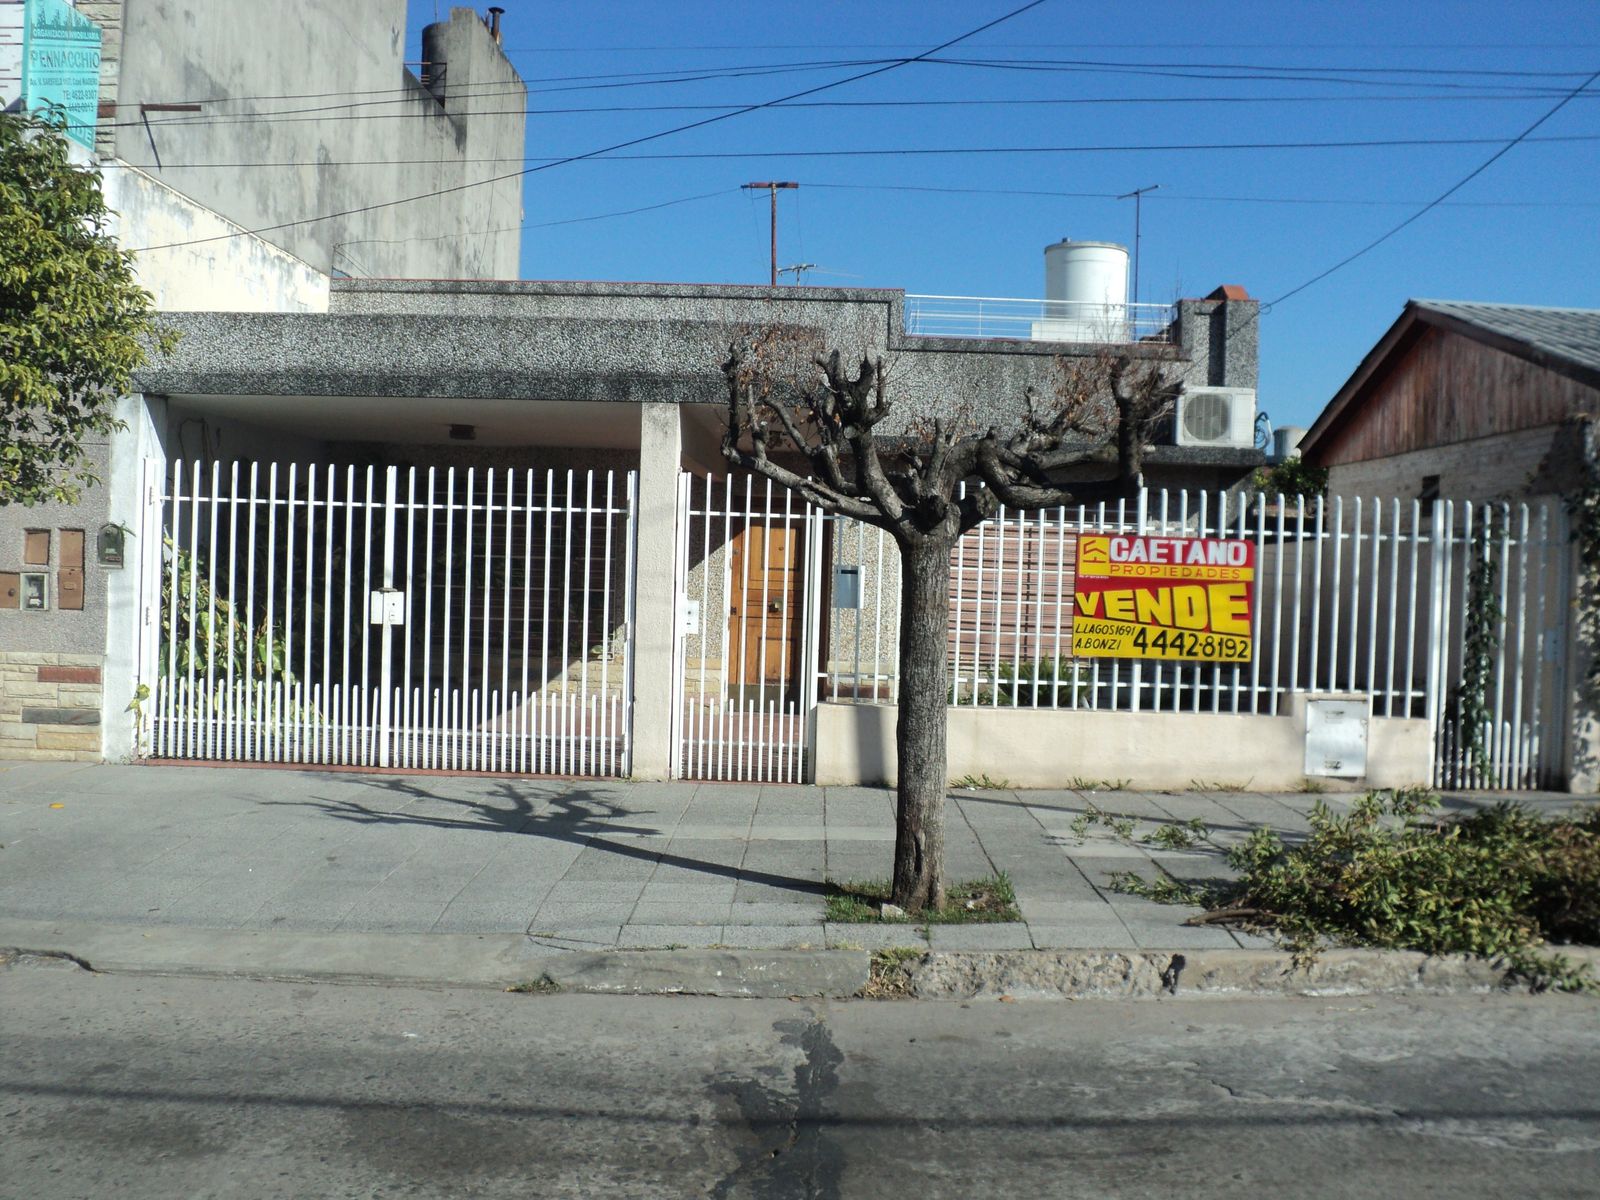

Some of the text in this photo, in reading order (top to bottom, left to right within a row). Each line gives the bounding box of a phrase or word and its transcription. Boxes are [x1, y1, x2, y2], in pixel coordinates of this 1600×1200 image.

[31, 50, 99, 69] PENNACCHIO
[1110, 537, 1247, 566] CAETANO
[1110, 564, 1240, 579] PROPIEDADES
[1075, 582, 1251, 637] VENDE
[1075, 638, 1121, 650] A.BONZI
